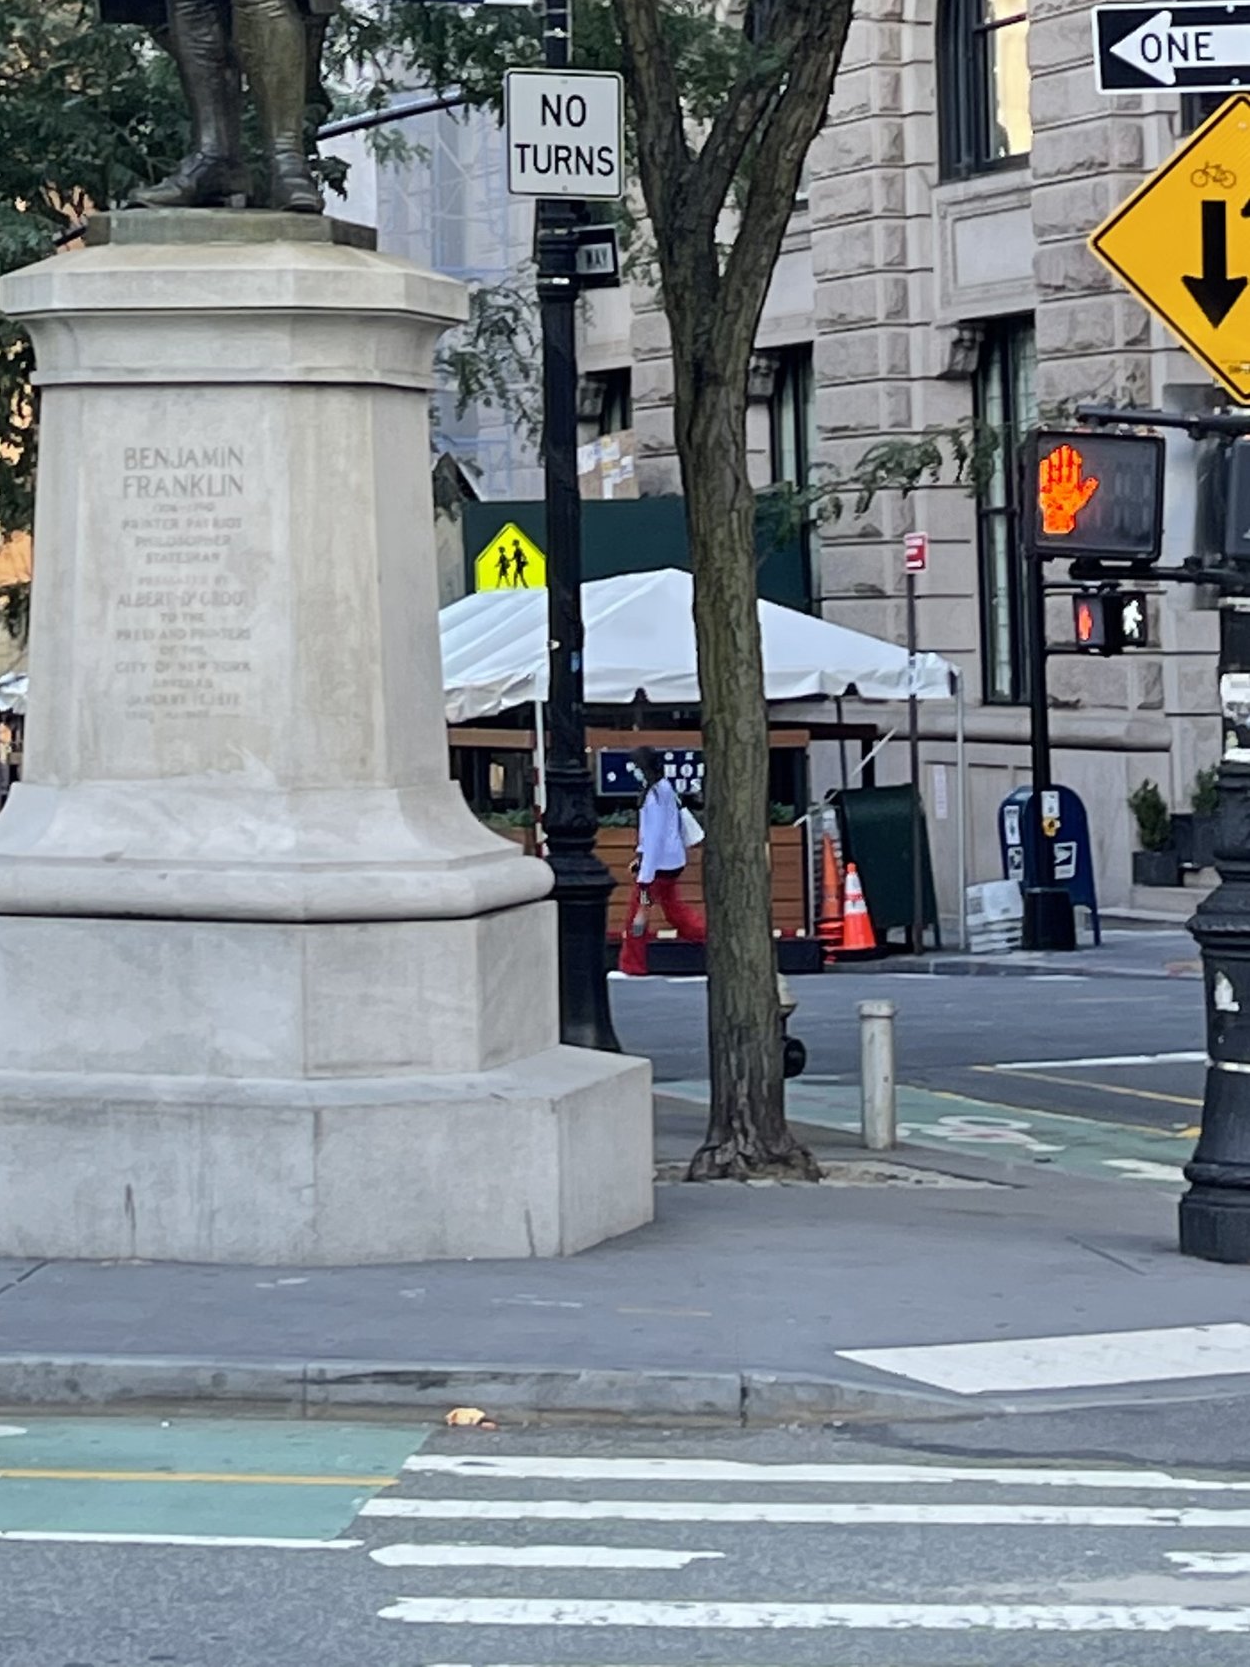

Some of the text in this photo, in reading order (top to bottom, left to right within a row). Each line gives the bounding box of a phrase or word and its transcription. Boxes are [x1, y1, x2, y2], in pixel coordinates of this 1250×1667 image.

[1141, 32, 1215, 63] ONE
[541, 93, 587, 127] NO
[514, 143, 615, 177] TURNS
[124, 446, 244, 470] BENJAMIN
[122, 474, 244, 499] FRANKLIN
